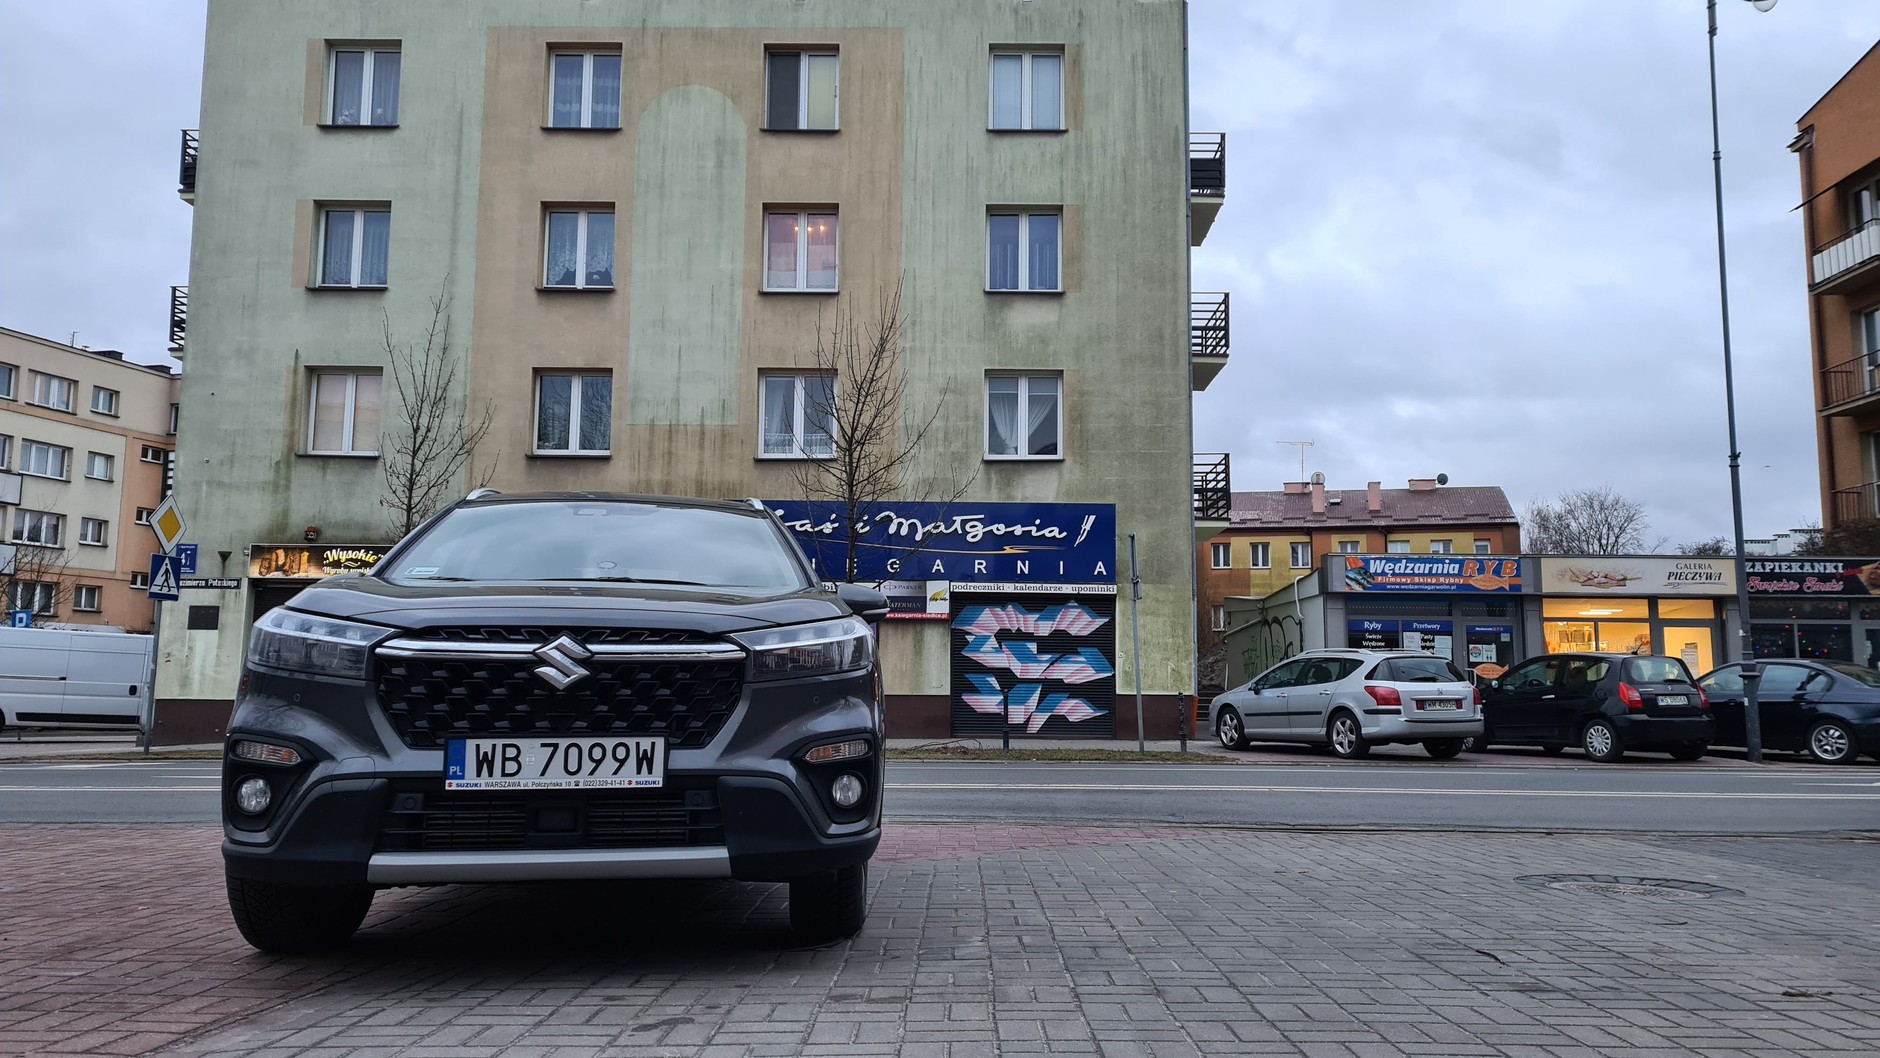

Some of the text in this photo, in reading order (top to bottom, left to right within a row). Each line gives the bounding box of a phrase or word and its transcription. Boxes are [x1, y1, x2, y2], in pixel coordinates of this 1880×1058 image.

[774, 509, 839, 534] aś
[875, 511, 1067, 543] Małgosia
[1369, 559, 1460, 577] Wędzarnia
[1676, 562, 1712, 570] GALERIA
[1746, 562, 1844, 573] ZAPIEKANKI
[1378, 576, 1411, 584] Firmowy
[1414, 576, 1437, 584] Sklep
[1667, 571, 1722, 581] PIECZYWA
[951, 582, 1116, 594] podręczniki kalendarze upominki
[1364, 621, 1382, 630] Ryby
[1413, 622, 1440, 630] Przetwory
[475, 741, 656, 778] WB 7099W
[449, 765, 463, 776] PL
